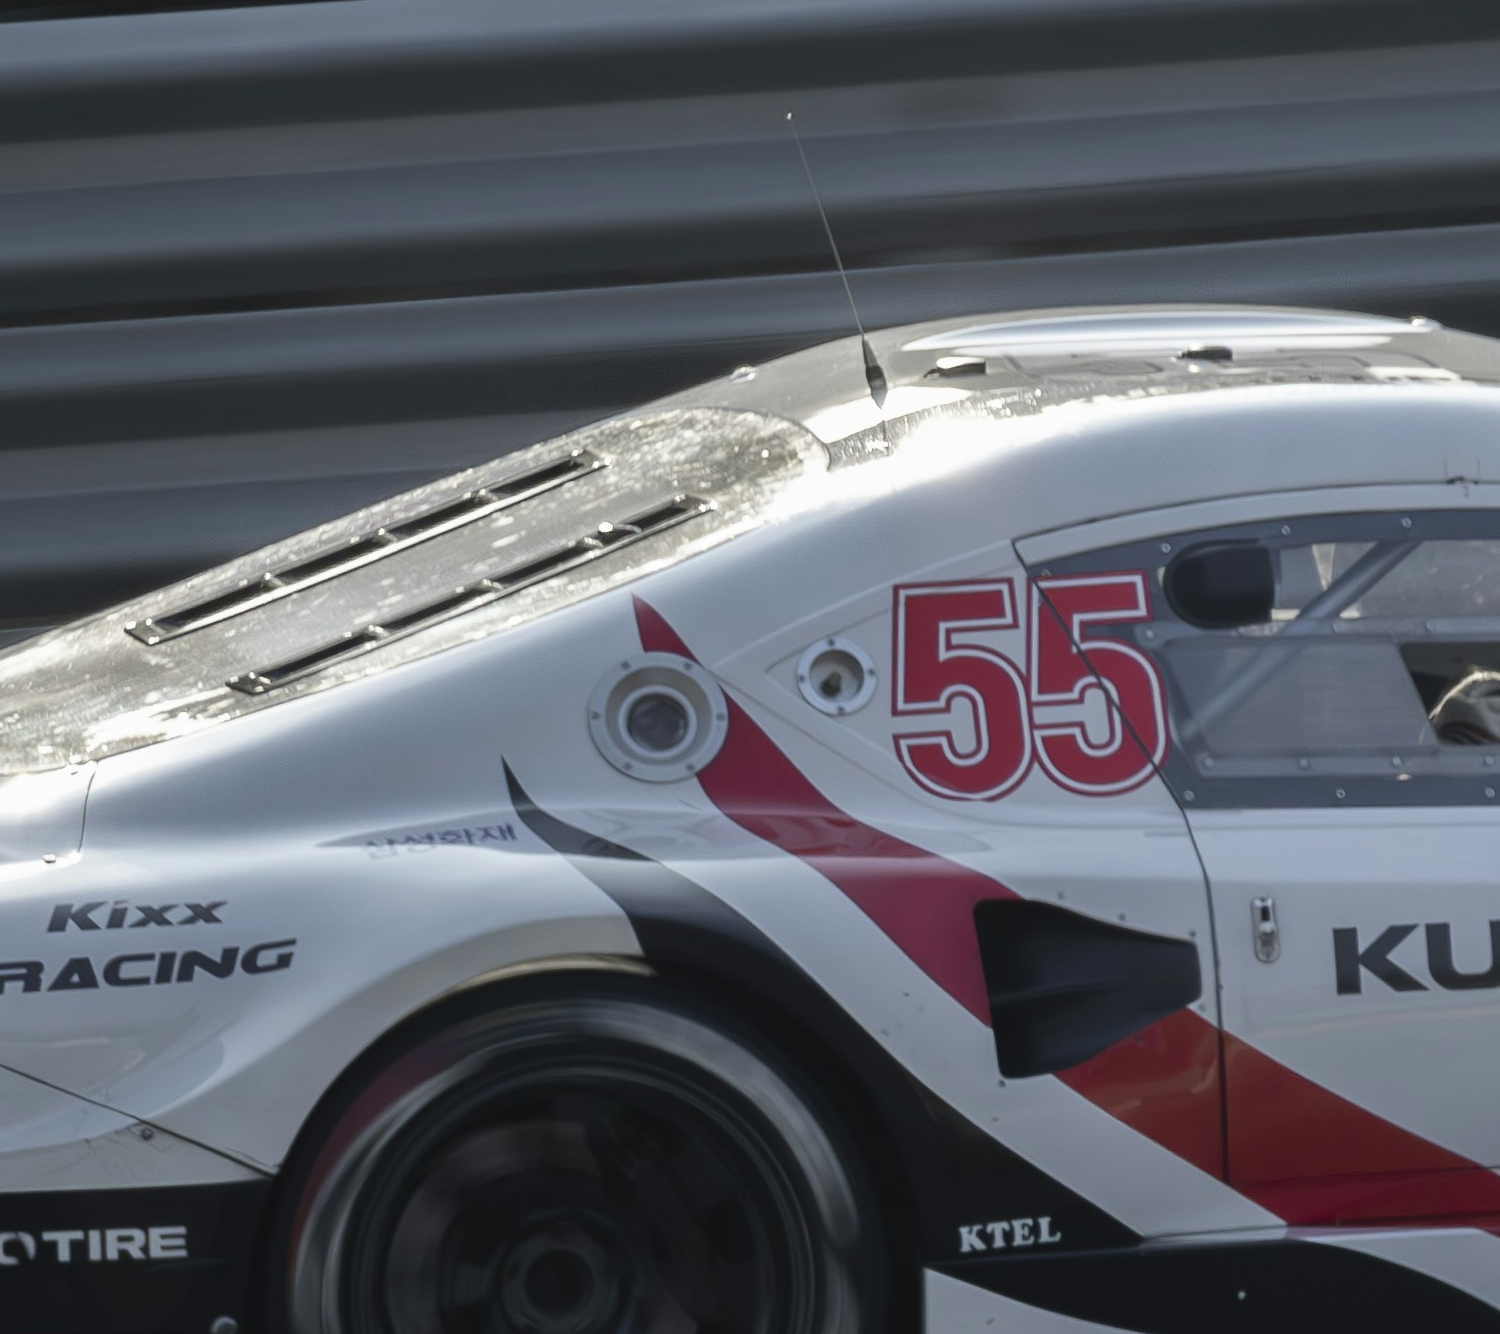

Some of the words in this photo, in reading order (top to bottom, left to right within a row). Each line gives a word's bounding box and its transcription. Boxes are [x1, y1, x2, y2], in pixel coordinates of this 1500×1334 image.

[891, 570, 1168, 802] 55
[47, 900, 228, 933] Kixx
[958, 1216, 1061, 1253] KTEL
